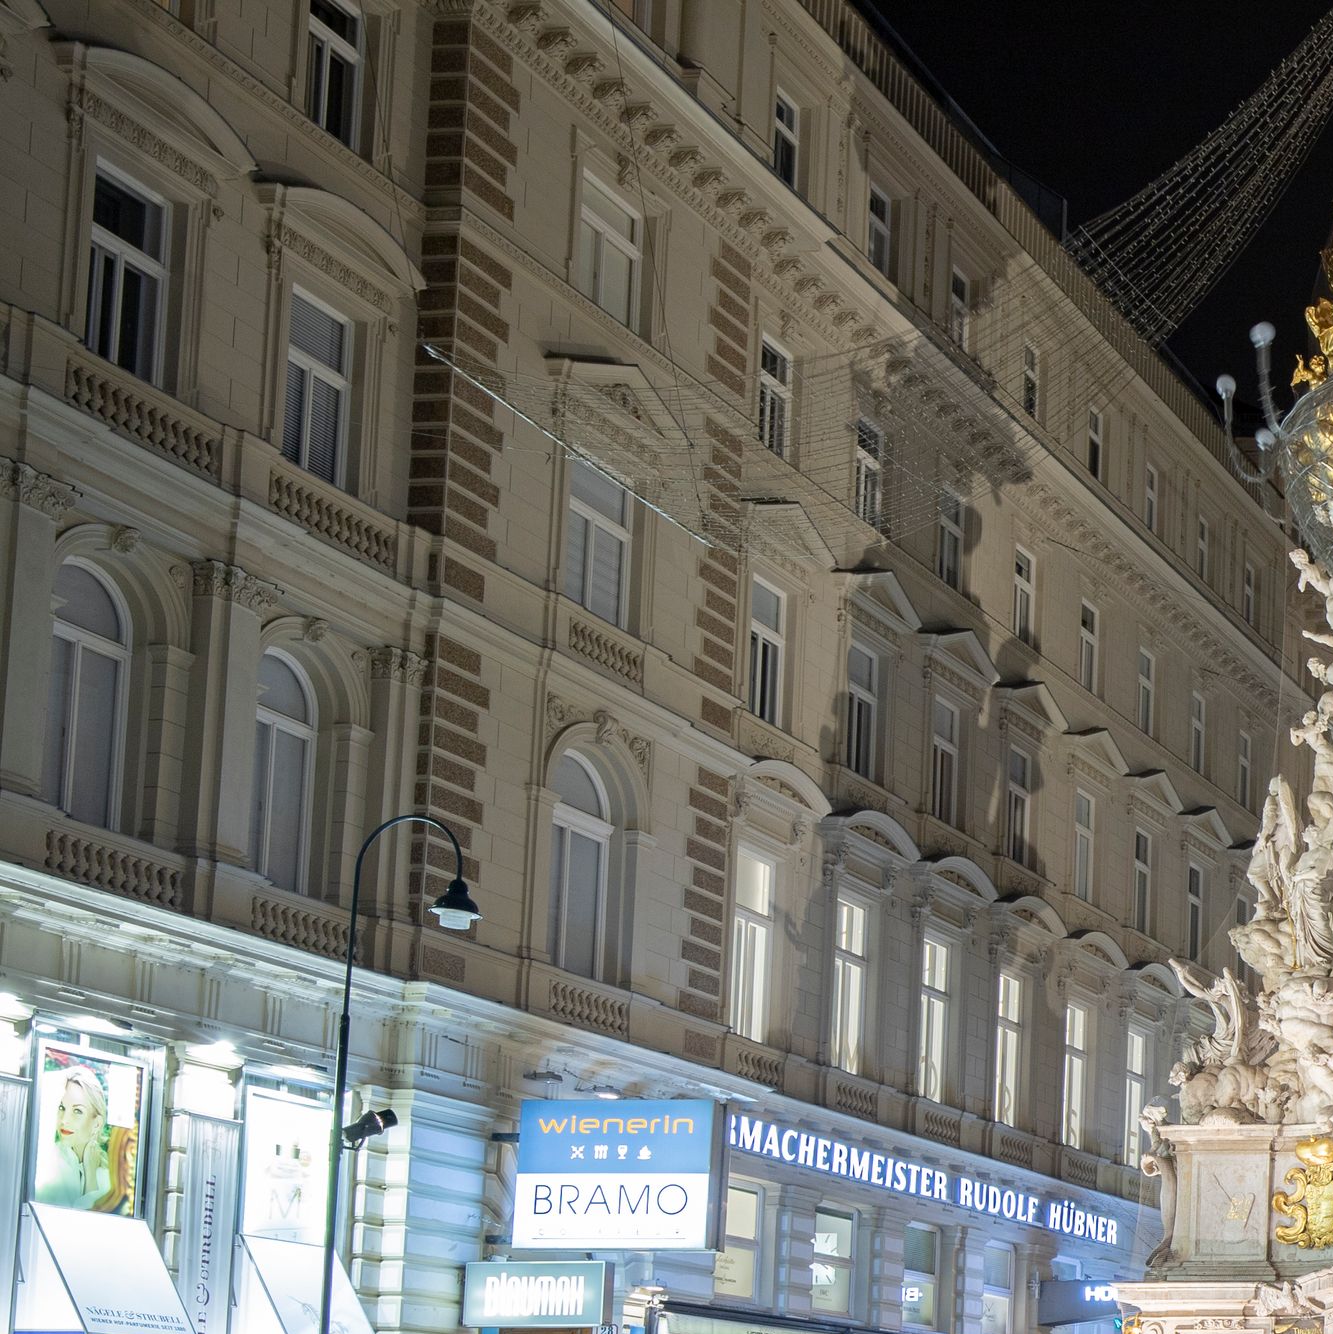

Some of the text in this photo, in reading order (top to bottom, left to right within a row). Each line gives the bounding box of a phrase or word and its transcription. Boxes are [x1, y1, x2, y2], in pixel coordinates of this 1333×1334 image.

[538, 1115, 694, 1134] wienerin
[731, 1114, 1118, 1245] MACHERMEISTER RUDOLF HÜBNER
[533, 1184, 688, 1215] BRAMO
[85, 1305, 124, 1318] NÄGELE
[136, 1314, 184, 1324] STRUBELL
